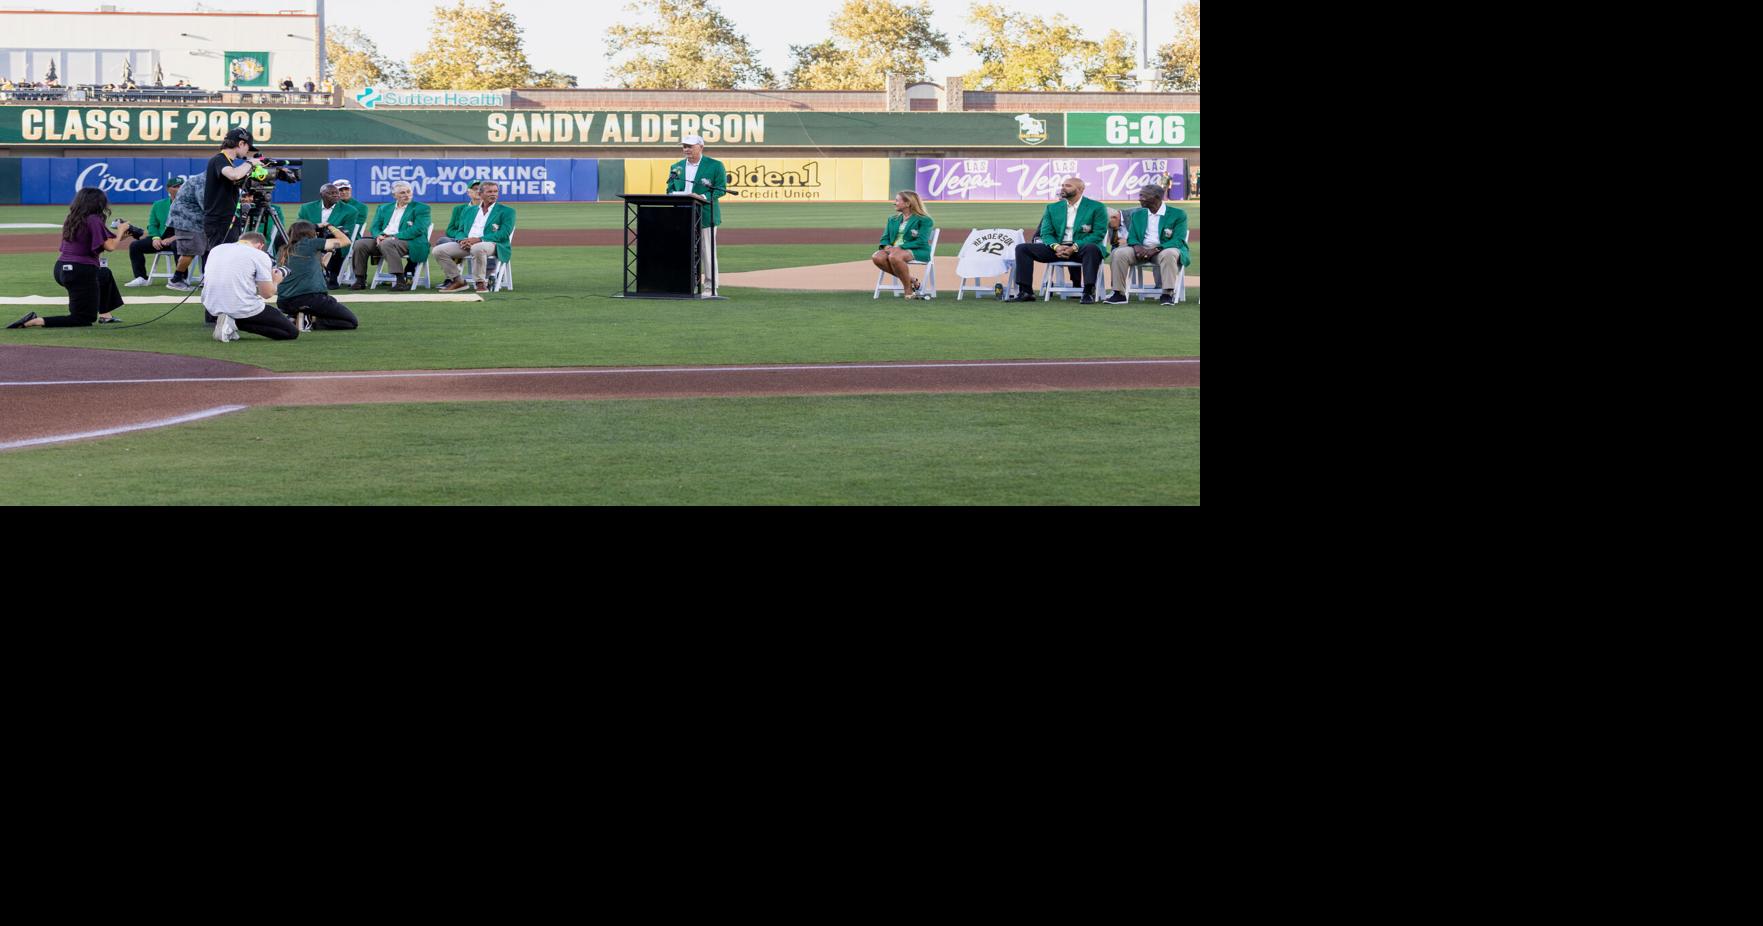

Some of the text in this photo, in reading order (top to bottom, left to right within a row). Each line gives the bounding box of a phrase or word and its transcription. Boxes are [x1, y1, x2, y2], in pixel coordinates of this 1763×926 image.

[384, 91, 503, 106] Sutter Health
[21, 108, 130, 141] CLASS
[138, 109, 180, 141] OF
[487, 112, 765, 143] SANDY ALDERSON
[1105, 115, 1186, 145] 6:06
[370, 165, 426, 180] NECA
[437, 166, 548, 181] WORKING
[965, 161, 987, 171] LAS
[1054, 161, 1076, 171] LAS
[1145, 161, 1166, 171] LAS
[75, 162, 164, 193] Circa
[918, 162, 1003, 198] Vegas
[370, 180, 427, 196] IBW
[439, 180, 557, 195] TOTHER
[741, 189, 820, 198] Credit Union
[976, 242, 1005, 256] 42
